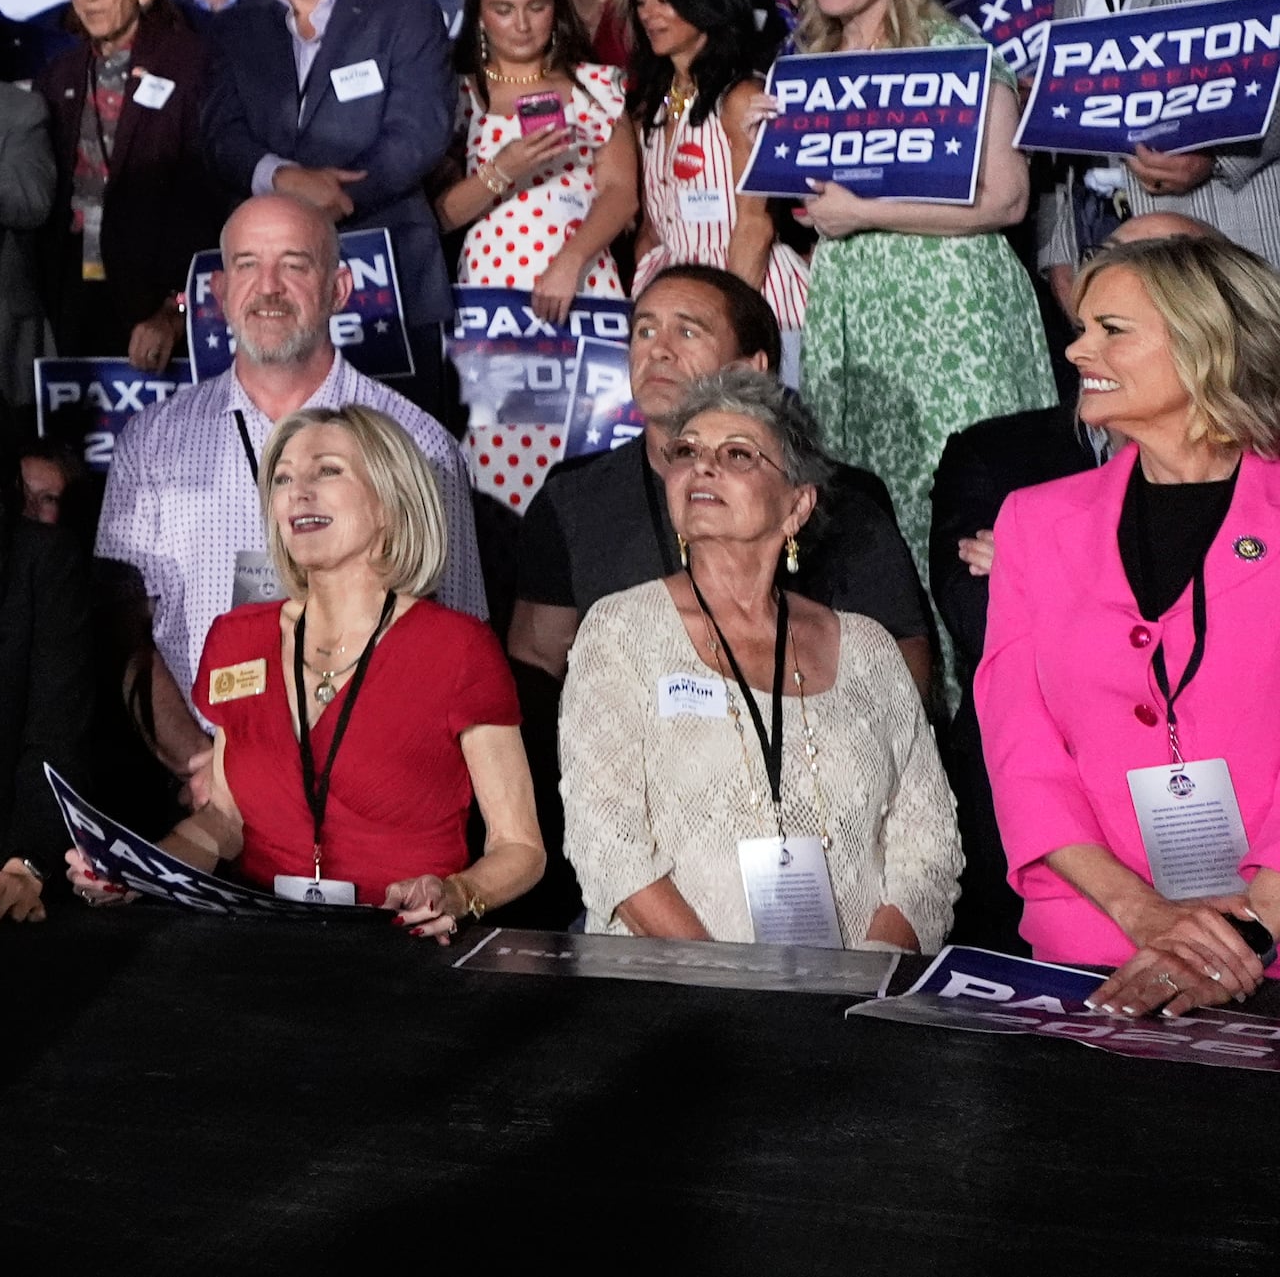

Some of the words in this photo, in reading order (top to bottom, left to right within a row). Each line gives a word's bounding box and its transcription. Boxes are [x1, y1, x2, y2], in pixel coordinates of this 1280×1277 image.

[1052, 14, 1280, 77] PAXTON
[775, 71, 980, 114] PAXTON
[1080, 77, 1237, 129] 2026
[795, 128, 935, 167] 2026
[454, 306, 629, 339] PAXTO
[47, 380, 192, 412] PAXT
